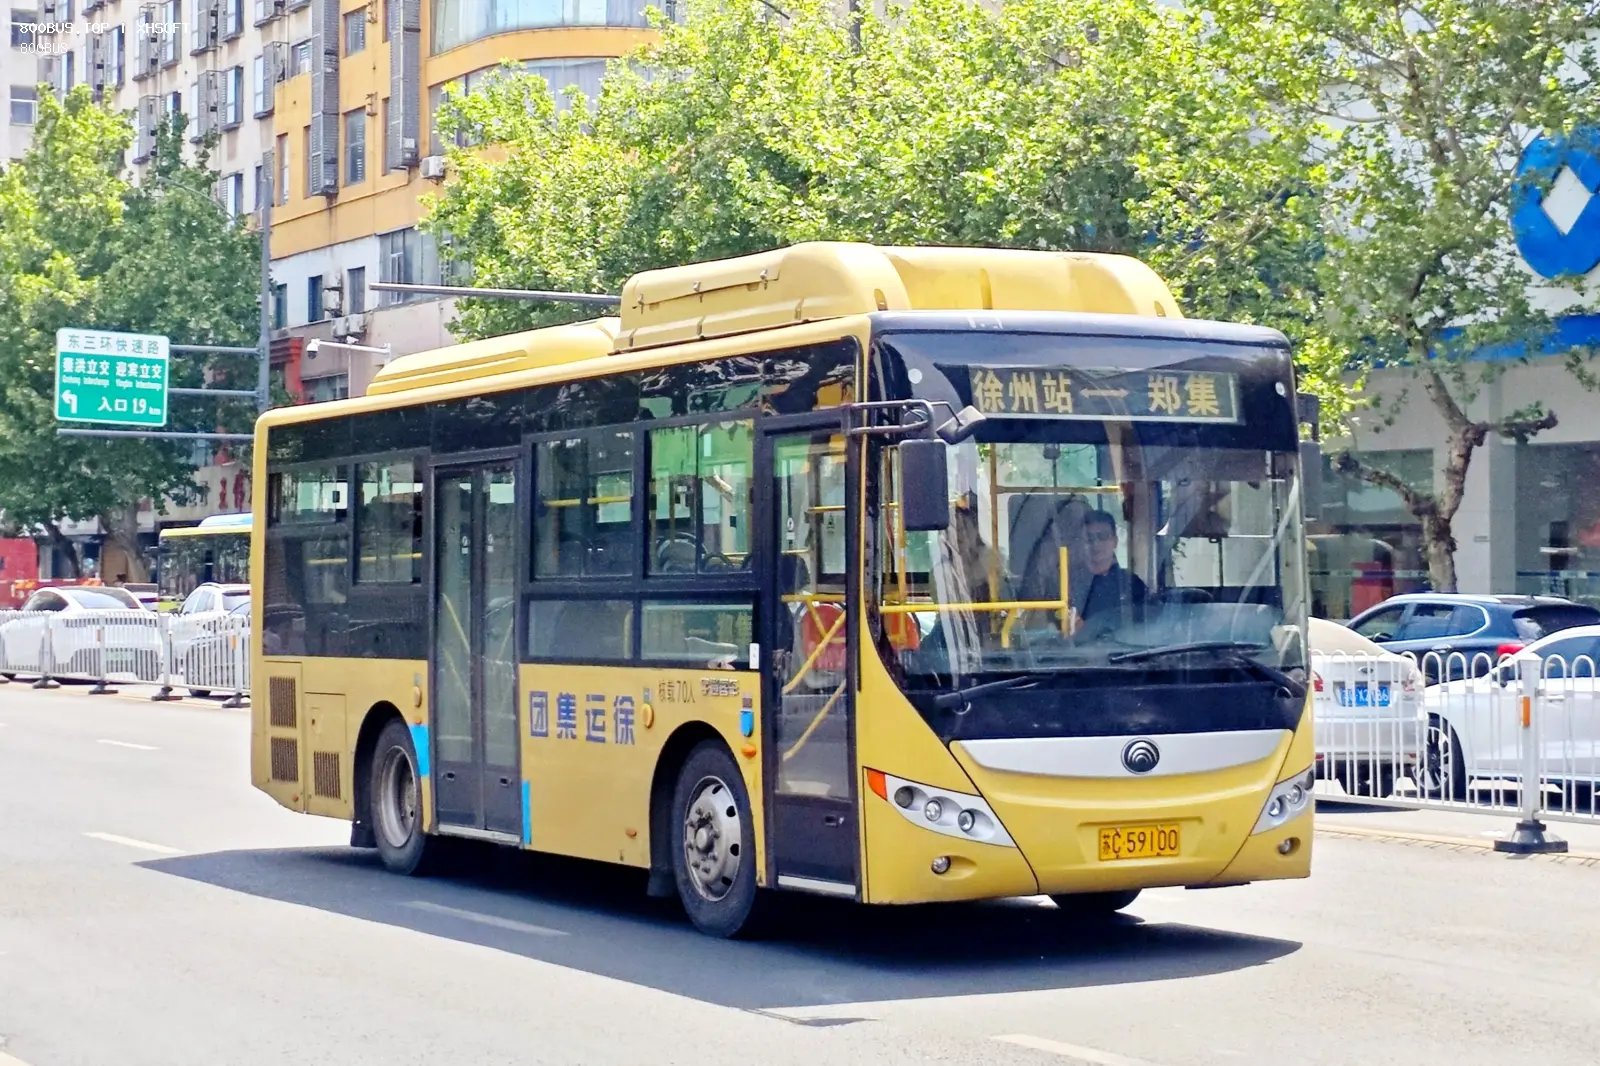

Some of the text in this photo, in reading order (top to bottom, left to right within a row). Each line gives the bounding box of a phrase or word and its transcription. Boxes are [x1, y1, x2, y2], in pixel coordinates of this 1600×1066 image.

[69, 335, 159, 354] 东三环快速路
[972, 369, 1221, 417] 徐州站 郑集
[98, 397, 128, 412] 入口
